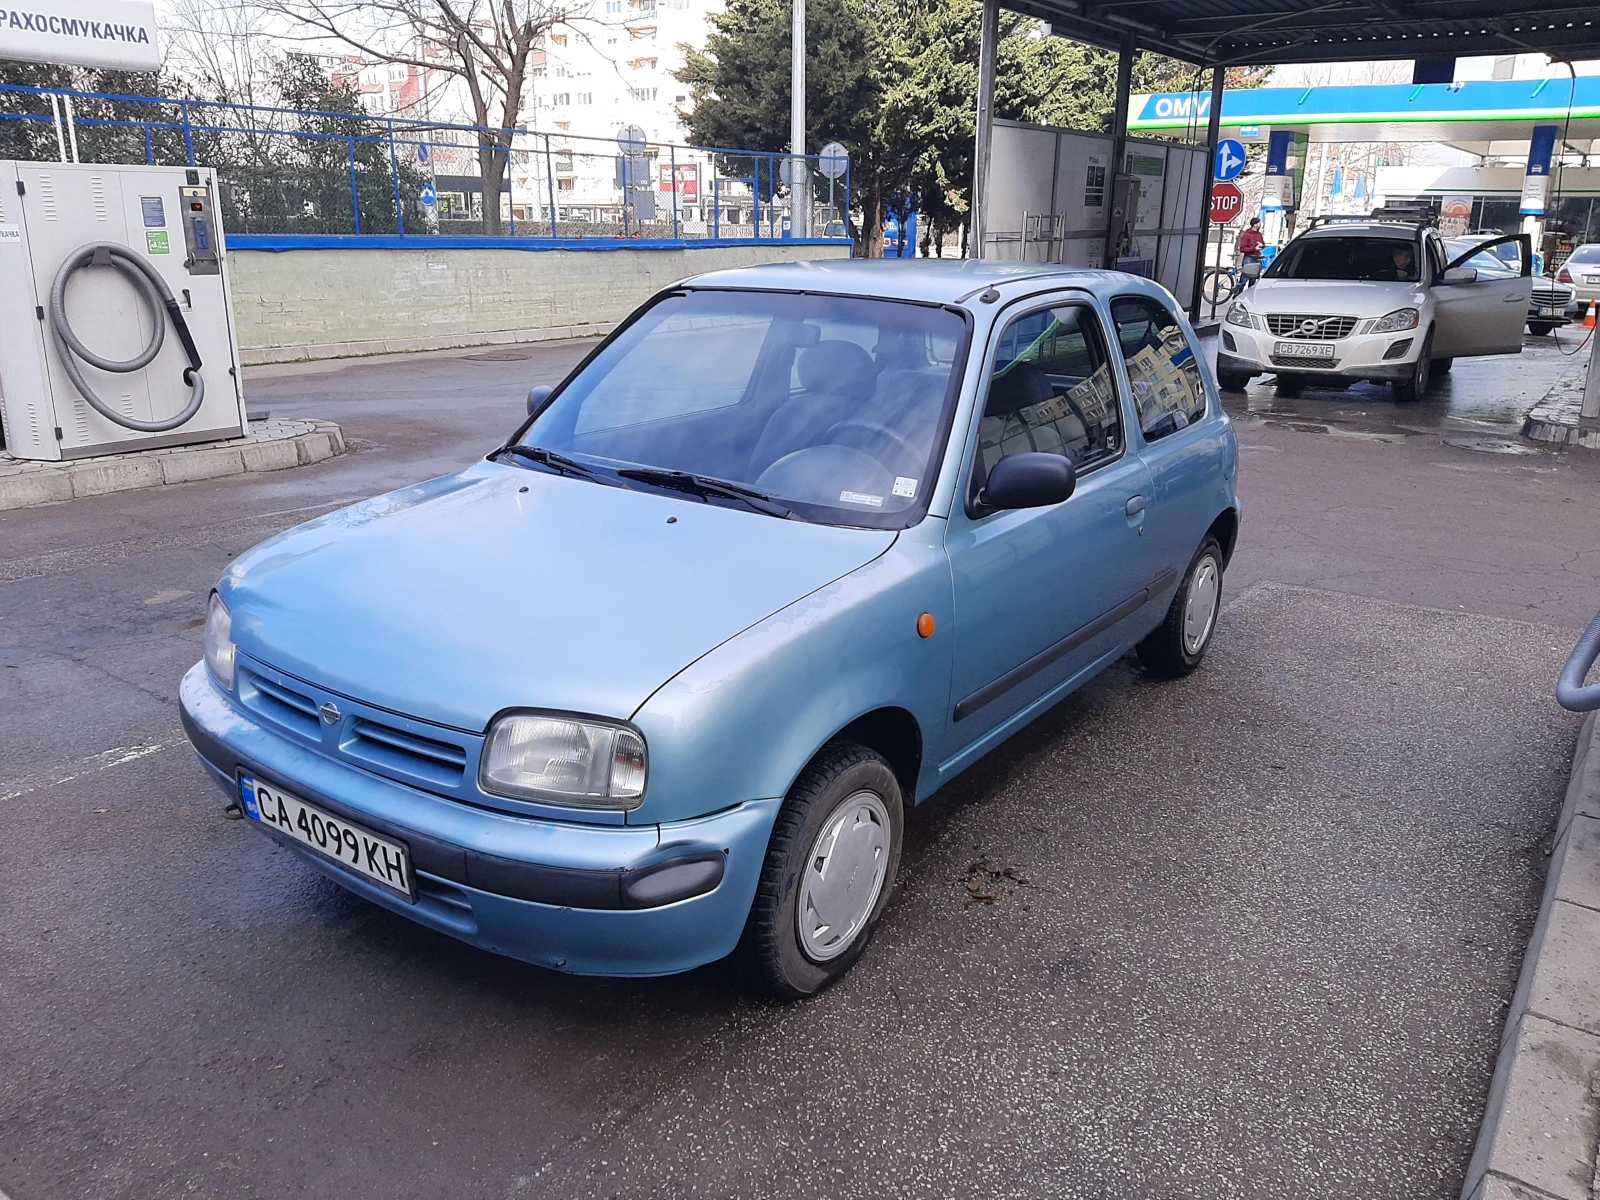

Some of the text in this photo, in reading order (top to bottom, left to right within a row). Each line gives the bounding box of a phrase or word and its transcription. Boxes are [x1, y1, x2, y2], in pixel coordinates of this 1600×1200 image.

[0, 9, 149, 44] РАХОСМУКАЧКА
[1155, 96, 1211, 117] OMV
[1210, 196, 1238, 210] STOP
[1281, 344, 1332, 356] CB 7269 XE
[257, 787, 406, 888] CA 4099 KH
